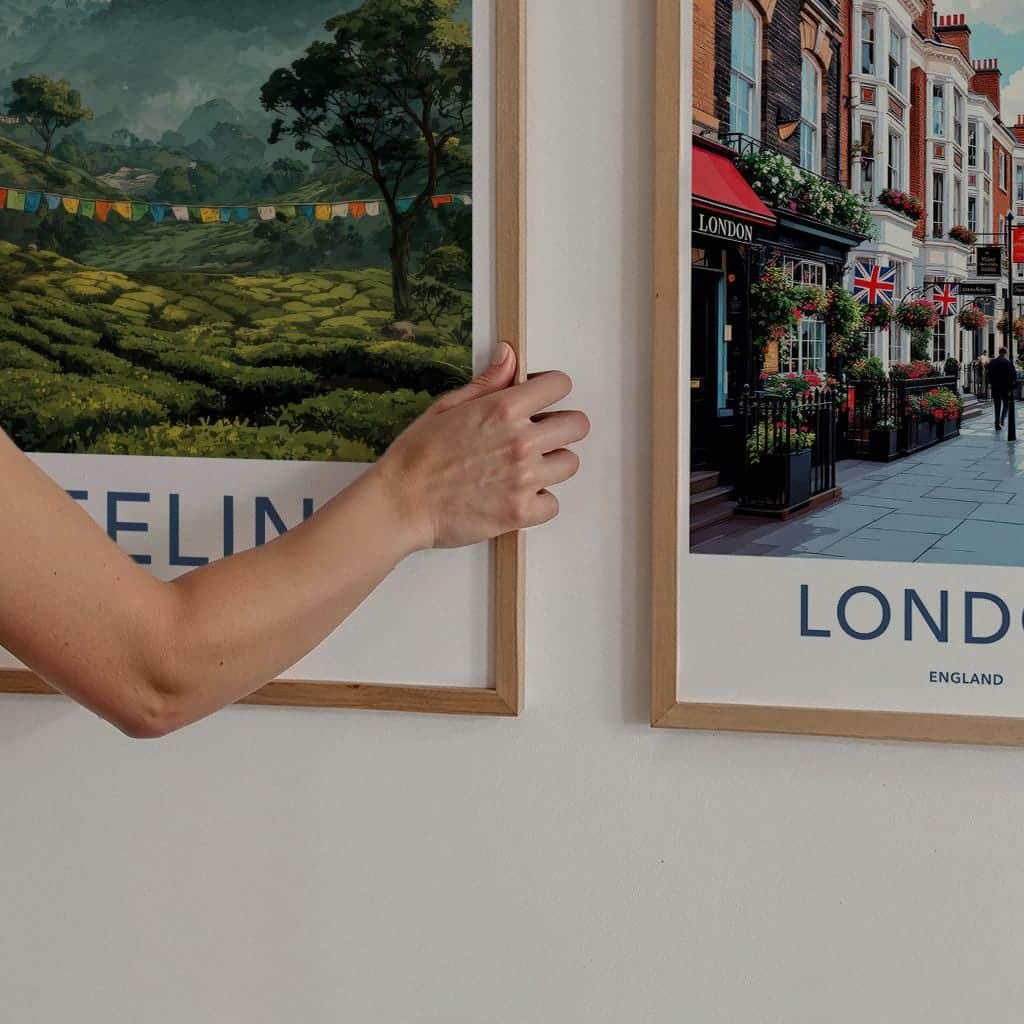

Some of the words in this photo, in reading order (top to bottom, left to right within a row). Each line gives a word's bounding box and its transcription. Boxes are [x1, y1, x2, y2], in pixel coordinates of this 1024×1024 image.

[699, 213, 753, 242] LONDON
[800, 584, 1024, 645] LOND
[928, 671, 1005, 687] ENGLAND
